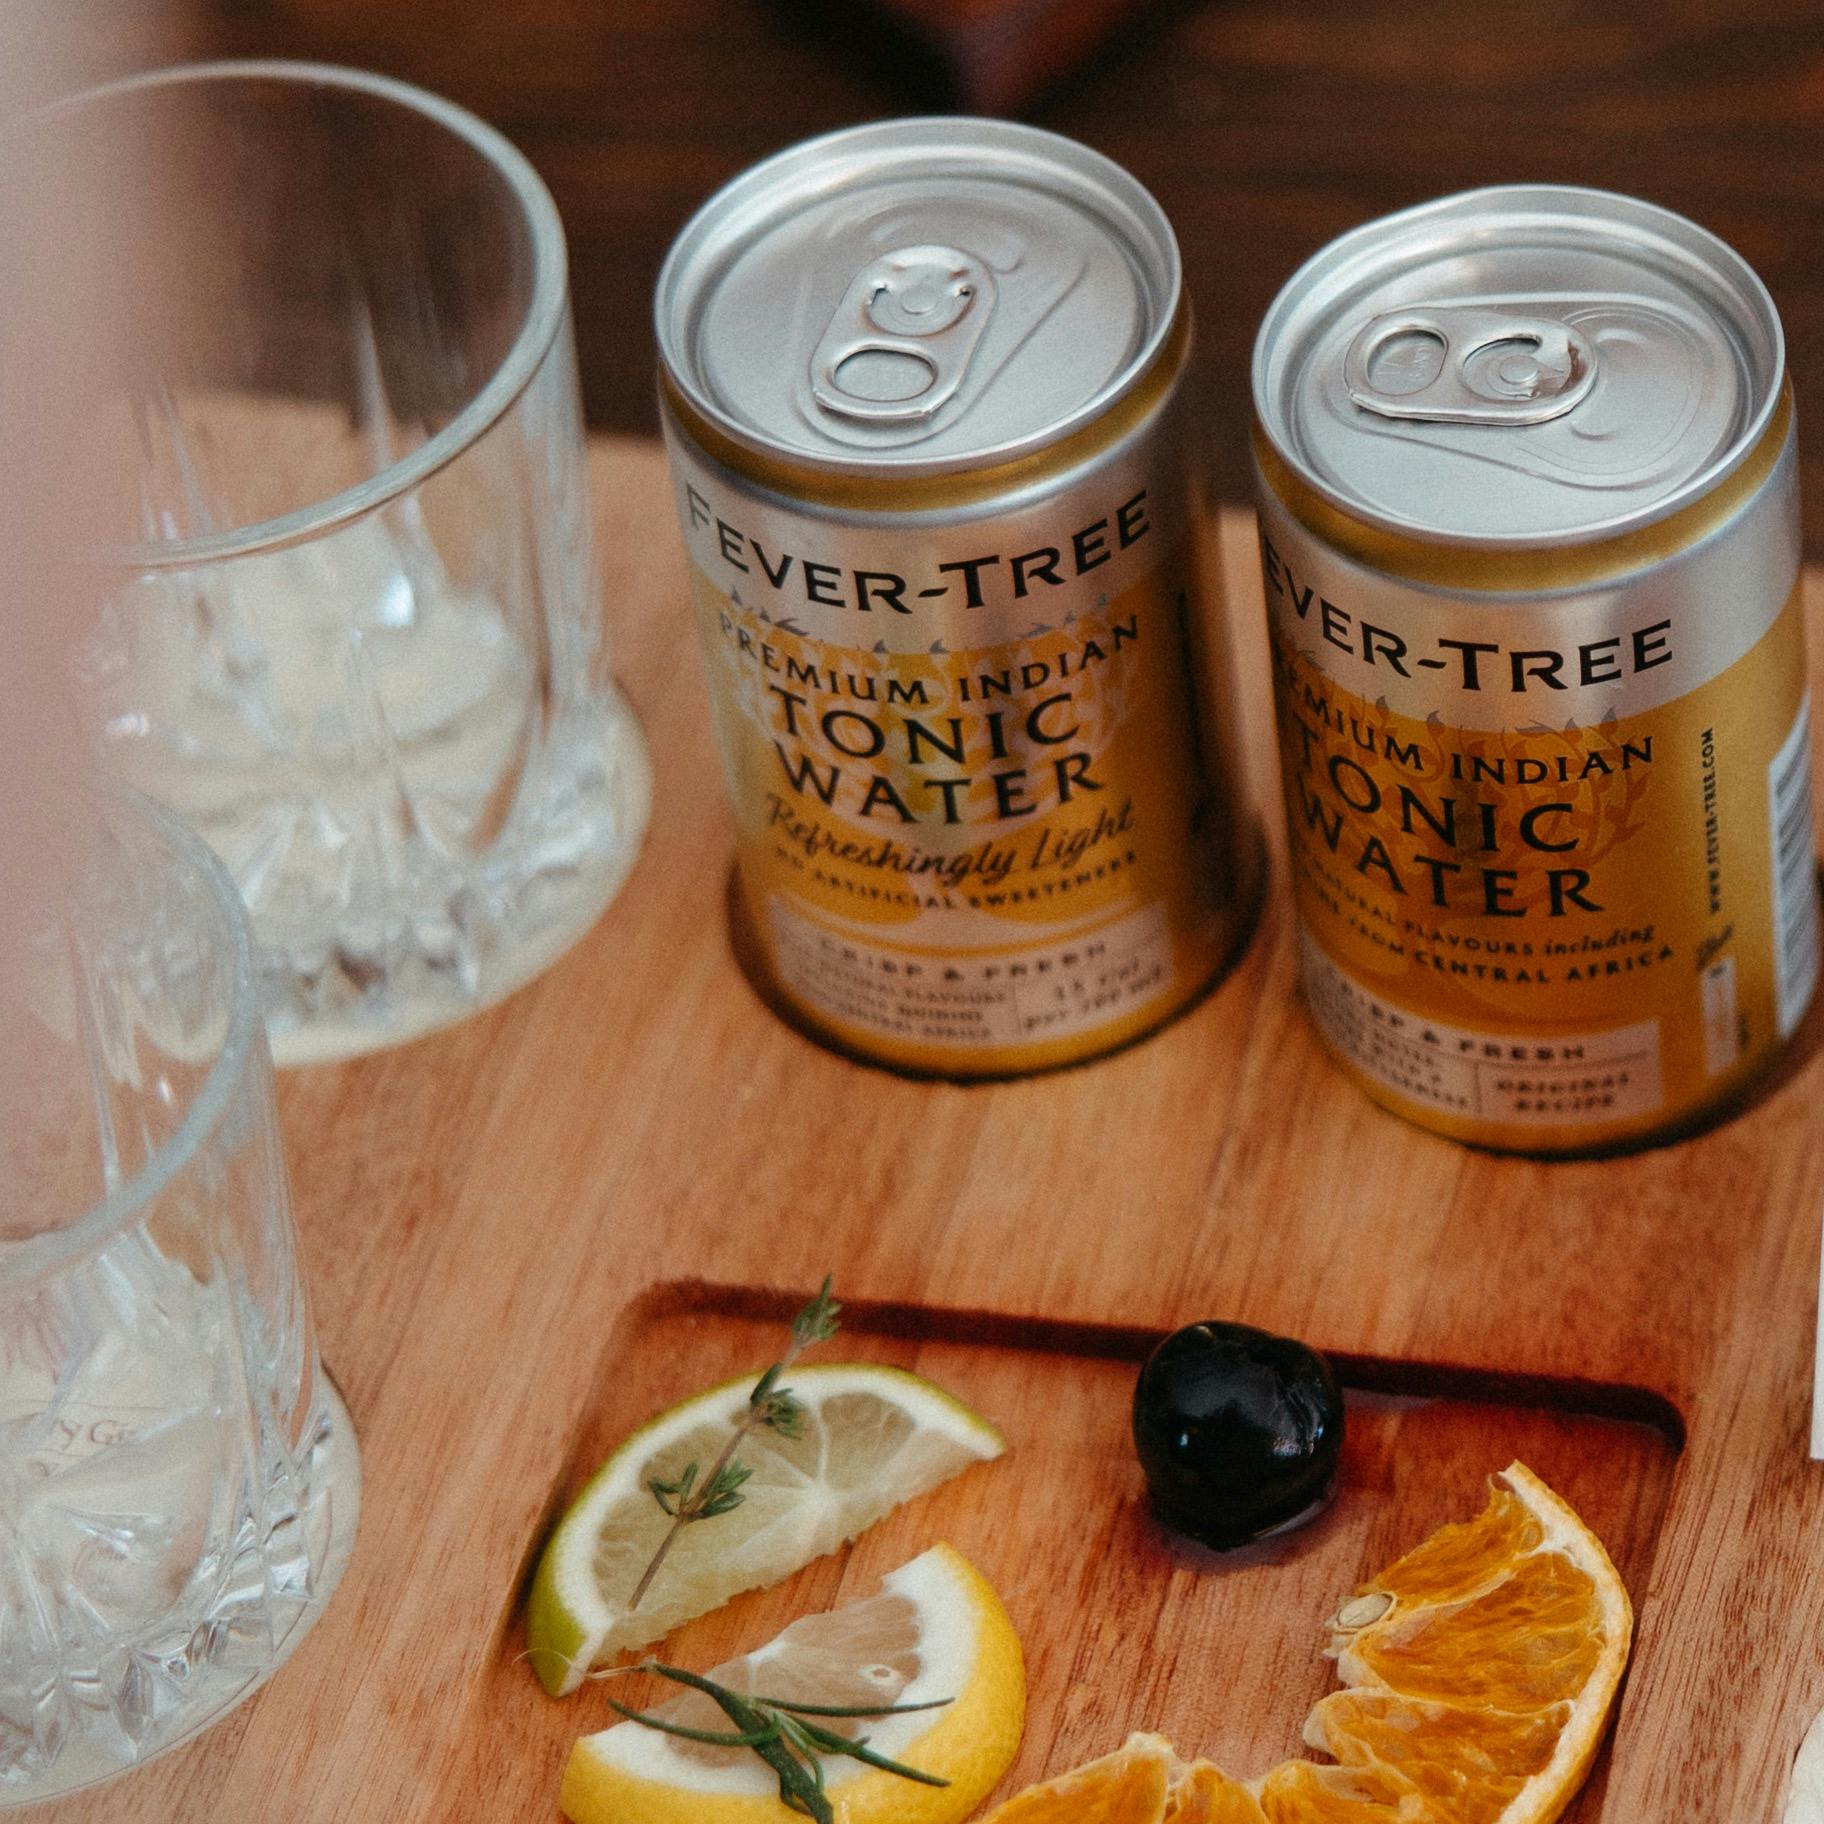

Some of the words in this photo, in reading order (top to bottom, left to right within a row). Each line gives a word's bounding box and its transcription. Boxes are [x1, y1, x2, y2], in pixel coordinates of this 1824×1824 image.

[686, 481, 1152, 615] FEVER-TREE
[720, 612, 930, 705] PREMIUM
[958, 613, 1139, 704] INDIAN
[1261, 535, 1674, 693] EVER-TREE
[770, 684, 1082, 766] TONIC
[1451, 735, 1655, 785] INDIAN
[773, 740, 1105, 825] WATER
[1293, 708, 1580, 853] TONIC
[764, 789, 1016, 887] Refreshingly
[1031, 794, 1136, 871] Light
[1295, 769, 1605, 918] WATER
[1405, 919, 1534, 956] FLAVOURS
[1544, 923, 1656, 957] including
[1414, 949, 1551, 984] CENTRAL
[1566, 944, 1674, 982] AFRICA
